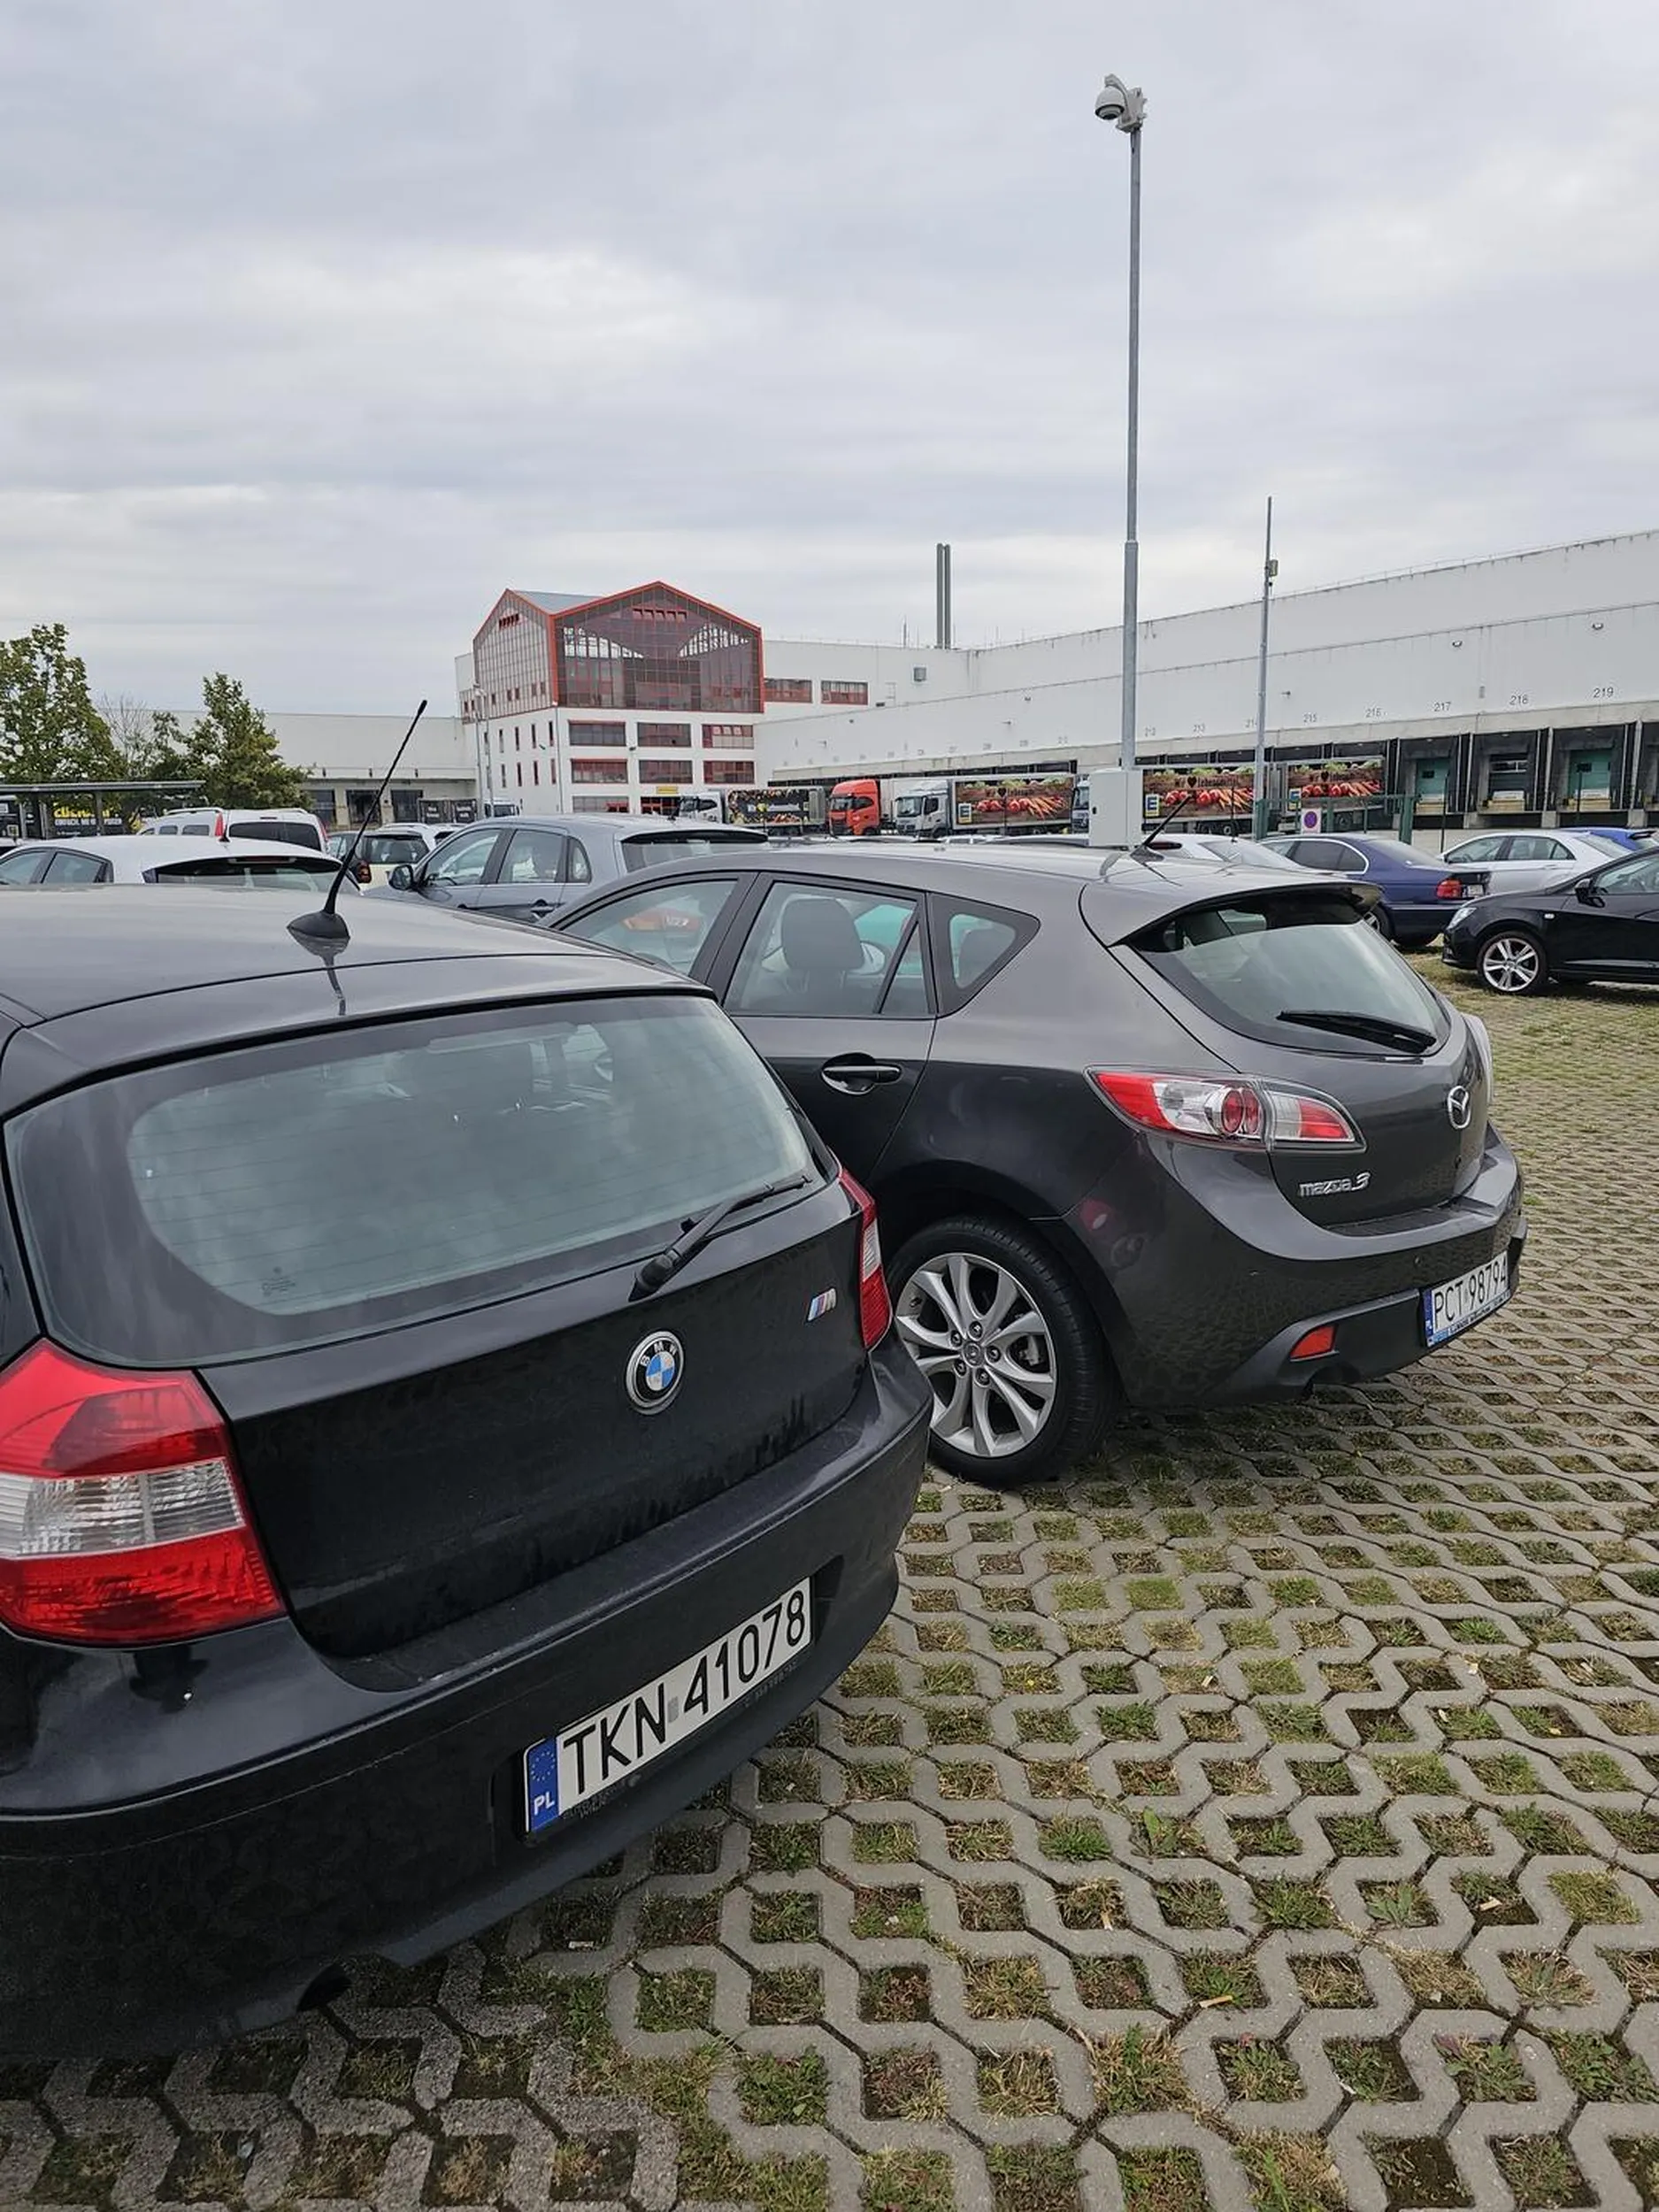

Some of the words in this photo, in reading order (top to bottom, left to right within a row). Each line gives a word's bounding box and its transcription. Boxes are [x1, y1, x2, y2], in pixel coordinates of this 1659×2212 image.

[1593, 687, 1614, 698] 219
[1434, 701, 1451, 711] 217
[1147, 796, 1157, 810] E
[1434, 1280, 1463, 1329] PCT
[1469, 1254, 1506, 1310] 98794
[640, 1340, 679, 1367] BMW
[563, 1682, 667, 1795] TKN
[683, 1590, 806, 1716] 41078
[534, 1791, 556, 1816] PL
